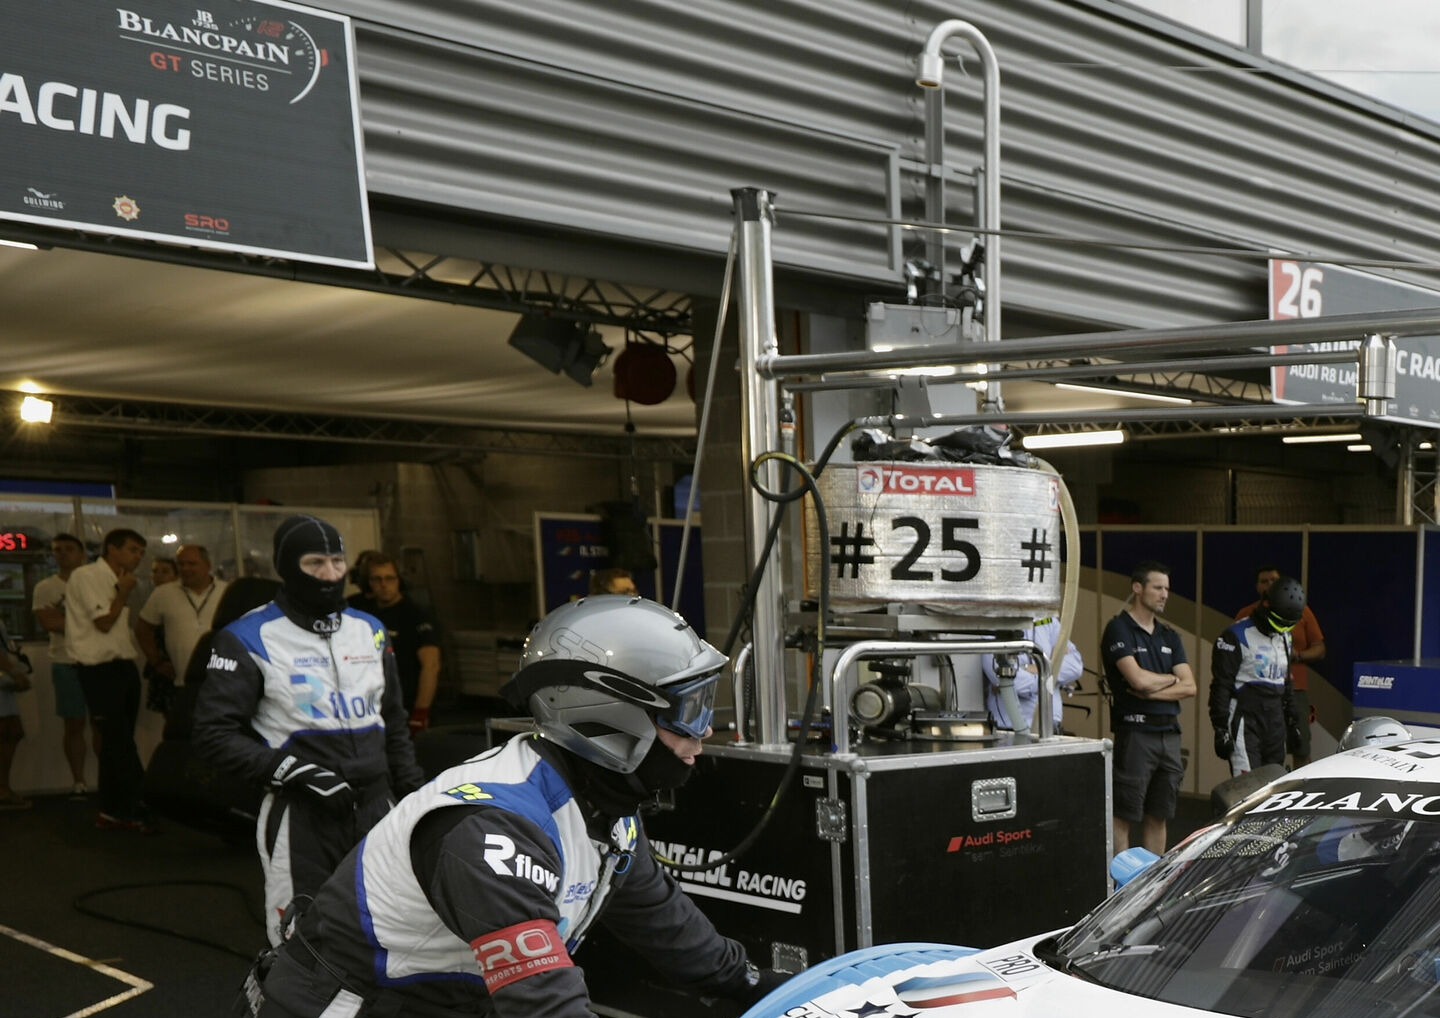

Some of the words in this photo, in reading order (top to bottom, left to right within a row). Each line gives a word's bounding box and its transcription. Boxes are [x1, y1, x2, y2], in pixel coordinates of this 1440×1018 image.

[116, 8, 290, 65] BLANCPAIN
[150, 52, 182, 72] GT
[191, 60, 270, 91] SERIES
[184, 213, 229, 231] SRO
[1278, 262, 1323, 318] 26
[1289, 364, 1318, 380] AUDI
[1321, 366, 1336, 383] R8
[882, 470, 973, 492] TOTAL
[891, 516, 982, 582] 25
[964, 832, 994, 847] Audi
[997, 828, 1032, 846] Sport
[737, 870, 807, 901] RACING
[1314, 942, 1344, 959] Sport
[527, 955, 560, 969] GROUP
[990, 955, 1040, 976] PRO
